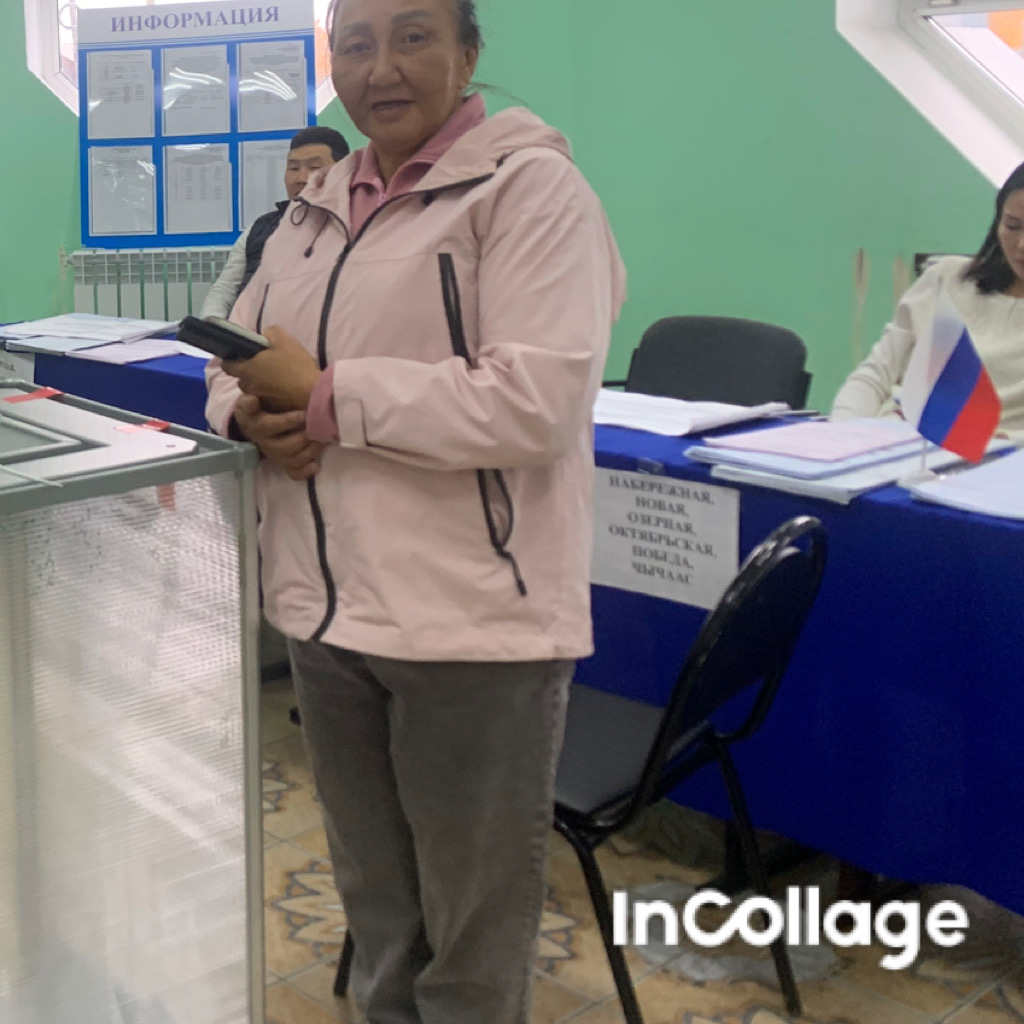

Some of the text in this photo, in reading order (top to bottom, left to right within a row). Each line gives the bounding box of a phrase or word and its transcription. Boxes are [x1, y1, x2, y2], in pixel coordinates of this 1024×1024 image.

[111, 6, 279, 33] ИНФОРМАЦИЯ
[609, 475, 715, 505] НАБЕРЕЖНАЯ,
[635, 495, 689, 517] НОВАЯ,
